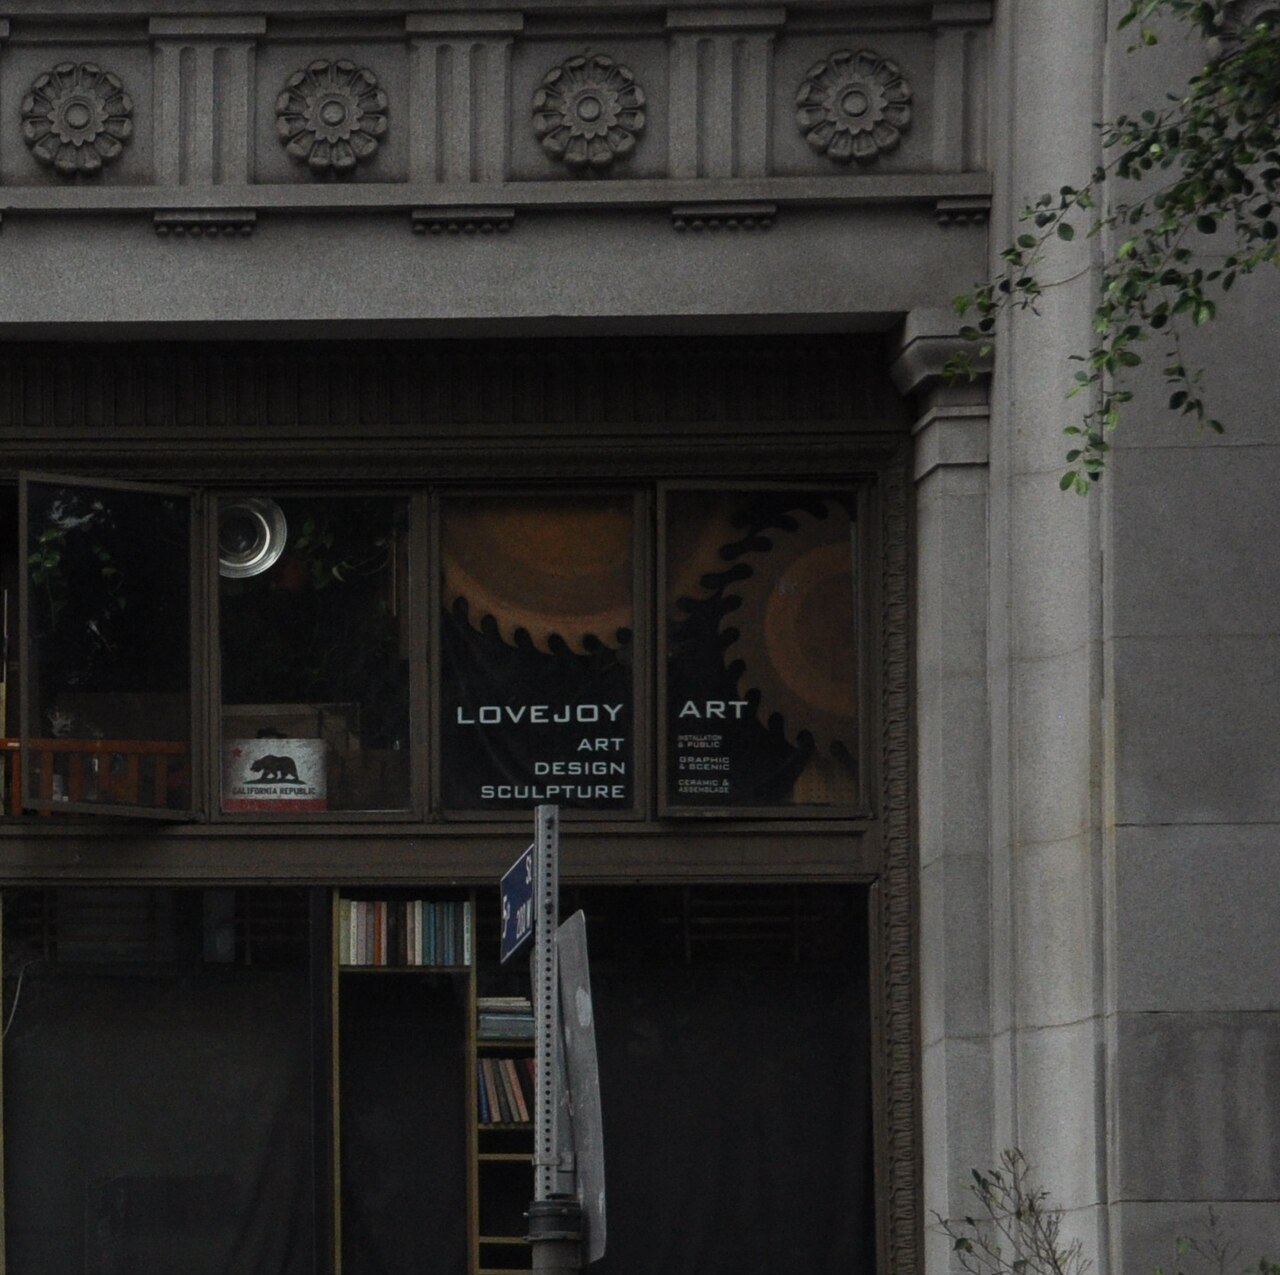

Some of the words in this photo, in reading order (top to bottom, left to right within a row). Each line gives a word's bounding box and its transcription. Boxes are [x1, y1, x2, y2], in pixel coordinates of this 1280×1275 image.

[456, 703, 624, 725] LOVEJOY
[678, 699, 750, 720] ART
[577, 737, 626, 752] ART
[534, 761, 626, 776] DESIGN
[678, 779, 719, 787] CERAMIC
[722, 778, 730, 786] &
[232, 787, 277, 795] CALIFORNIA
[280, 787, 316, 795] REPUBLIC
[480, 785, 626, 799] SCULPTURE
